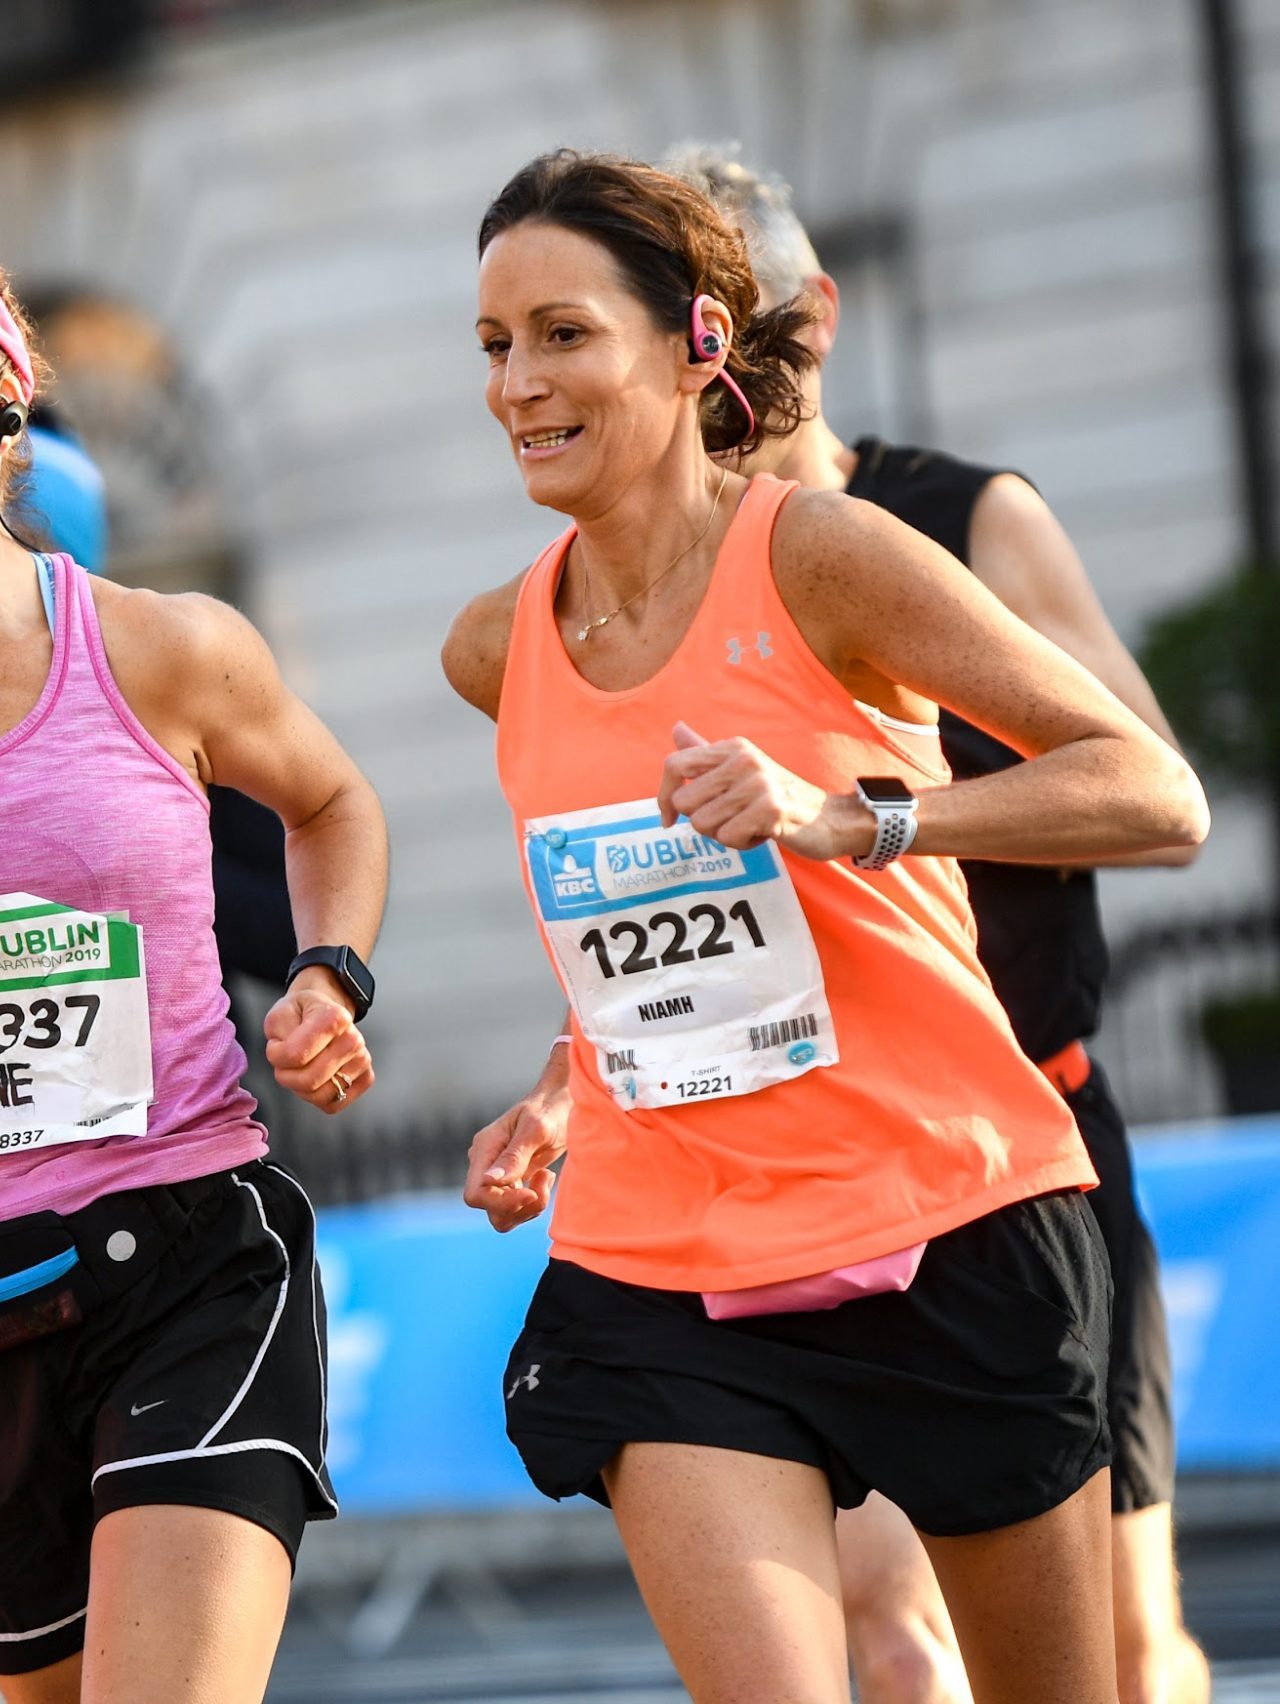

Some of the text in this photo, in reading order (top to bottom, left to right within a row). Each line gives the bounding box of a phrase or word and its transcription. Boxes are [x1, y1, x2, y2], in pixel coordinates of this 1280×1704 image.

[606, 833, 728, 874] DUBLIN
[613, 857, 733, 891] MARATHON 2019
[555, 877, 596, 897] KBC
[580, 899, 767, 980] 12221
[64, 947, 102, 964] 2019
[638, 995, 695, 1023] NIAMH
[691, 1064, 721, 1077] T-SHIRT
[676, 1075, 733, 1098] 12221
[0, 1129, 45, 1150] 8337
